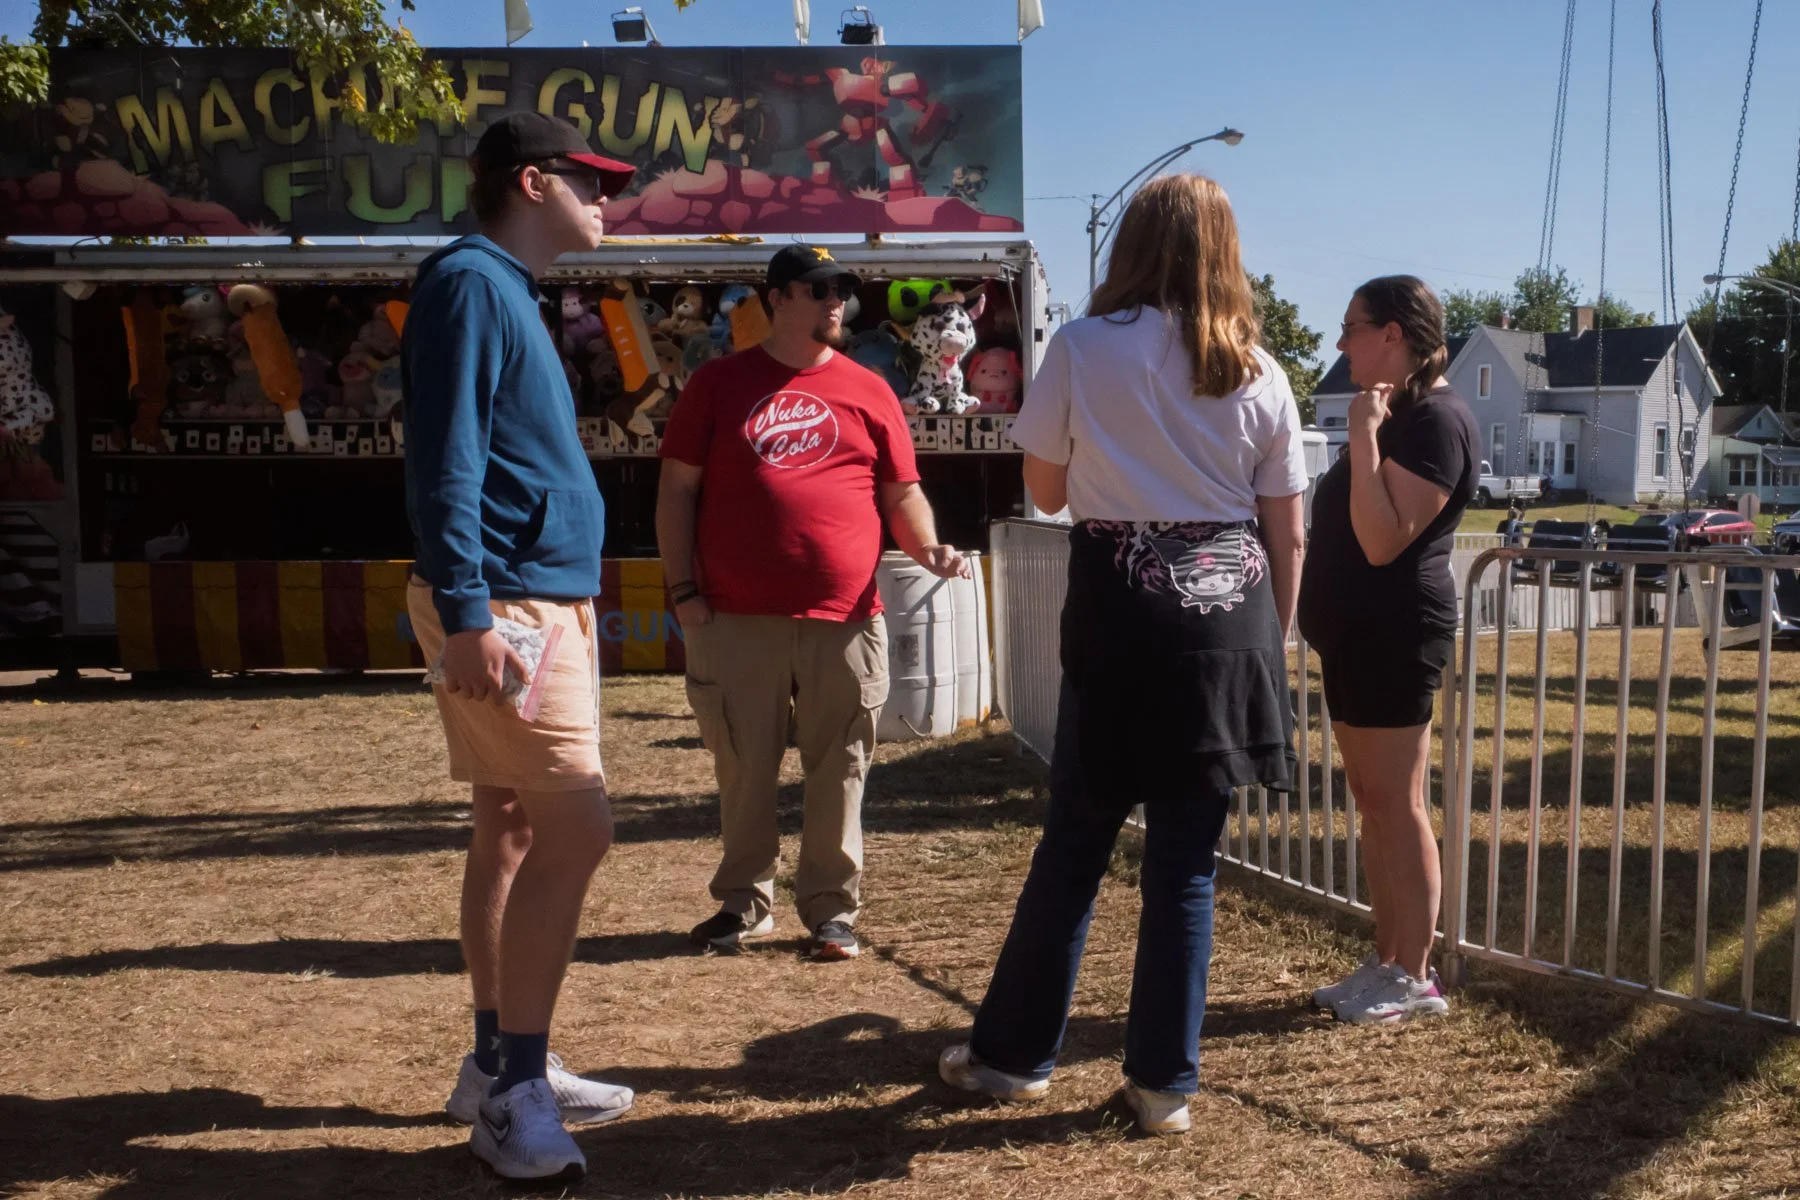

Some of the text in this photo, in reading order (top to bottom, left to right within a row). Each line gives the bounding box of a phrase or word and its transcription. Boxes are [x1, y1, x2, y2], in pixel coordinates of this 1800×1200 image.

[537, 67, 719, 175] GUN
[755, 397, 819, 433] Nuka
[768, 430, 822, 463] Cola
